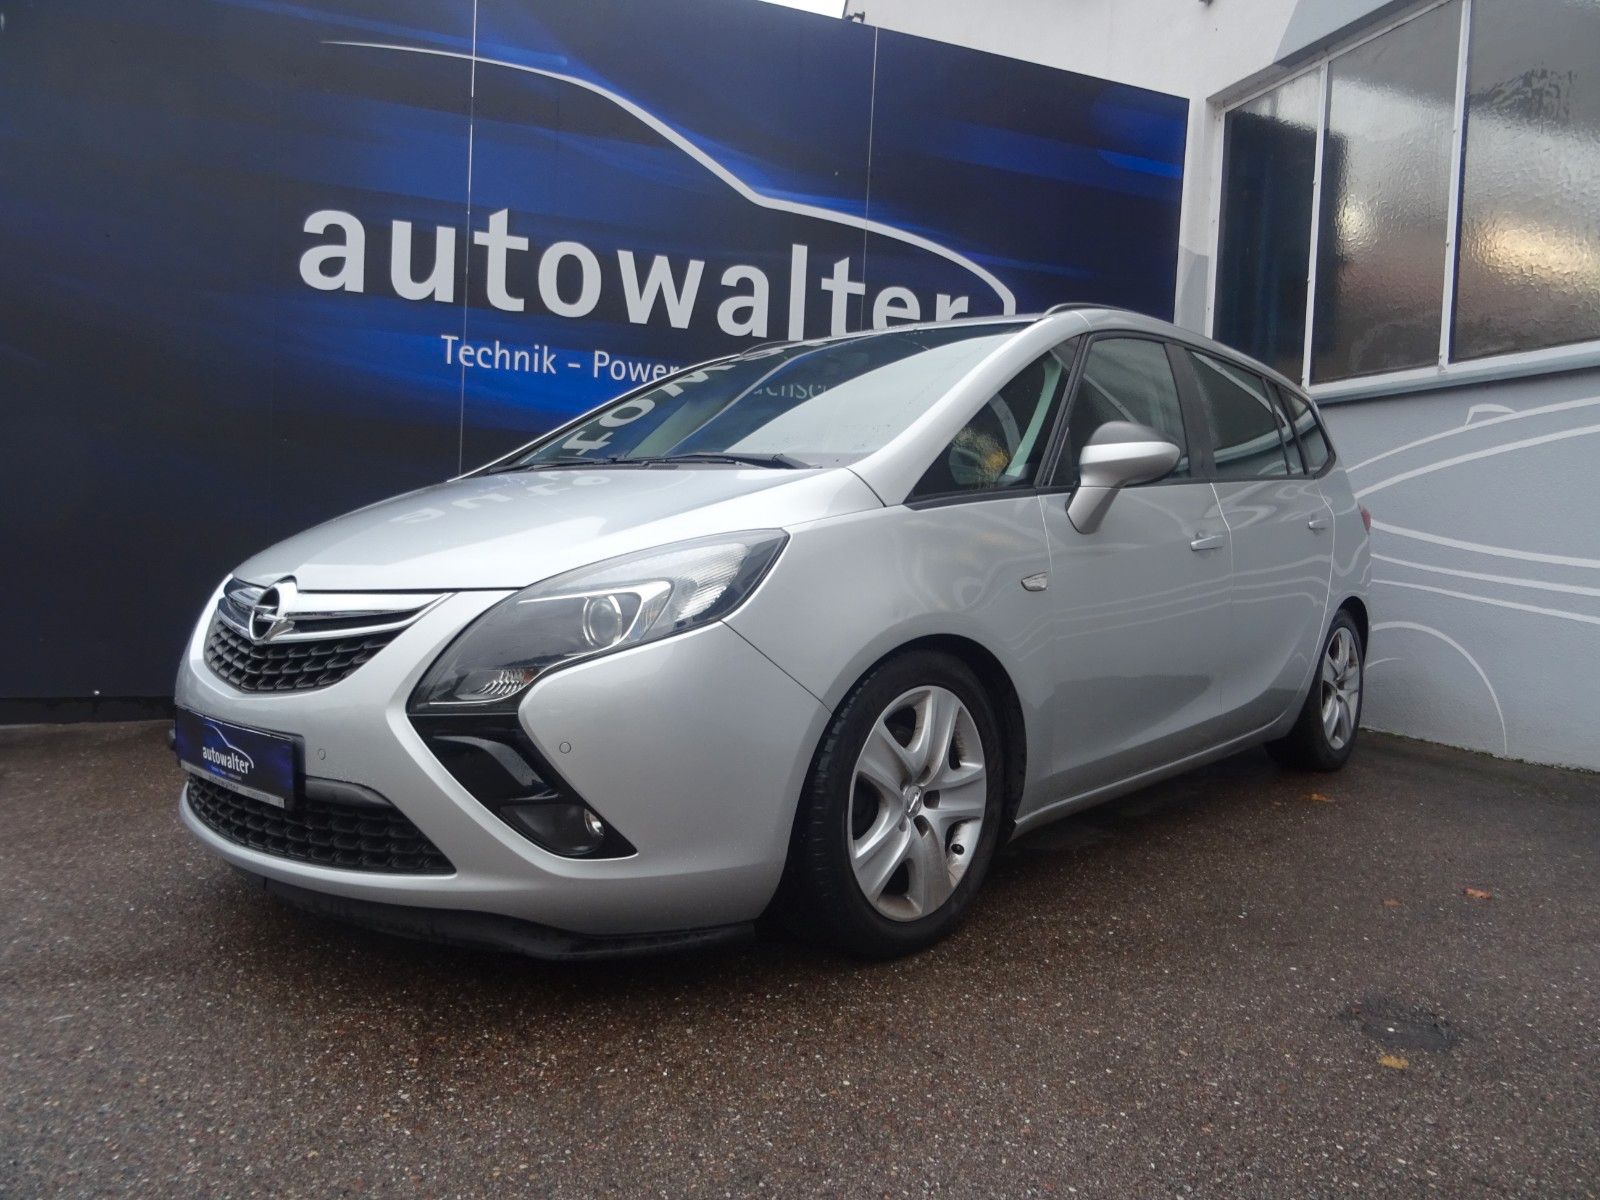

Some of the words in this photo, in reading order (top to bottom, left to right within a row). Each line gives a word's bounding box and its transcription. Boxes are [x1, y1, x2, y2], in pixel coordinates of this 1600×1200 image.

[299, 208, 969, 341] autowalter
[441, 335, 557, 374] Technik
[202, 746, 249, 774] autowalter
